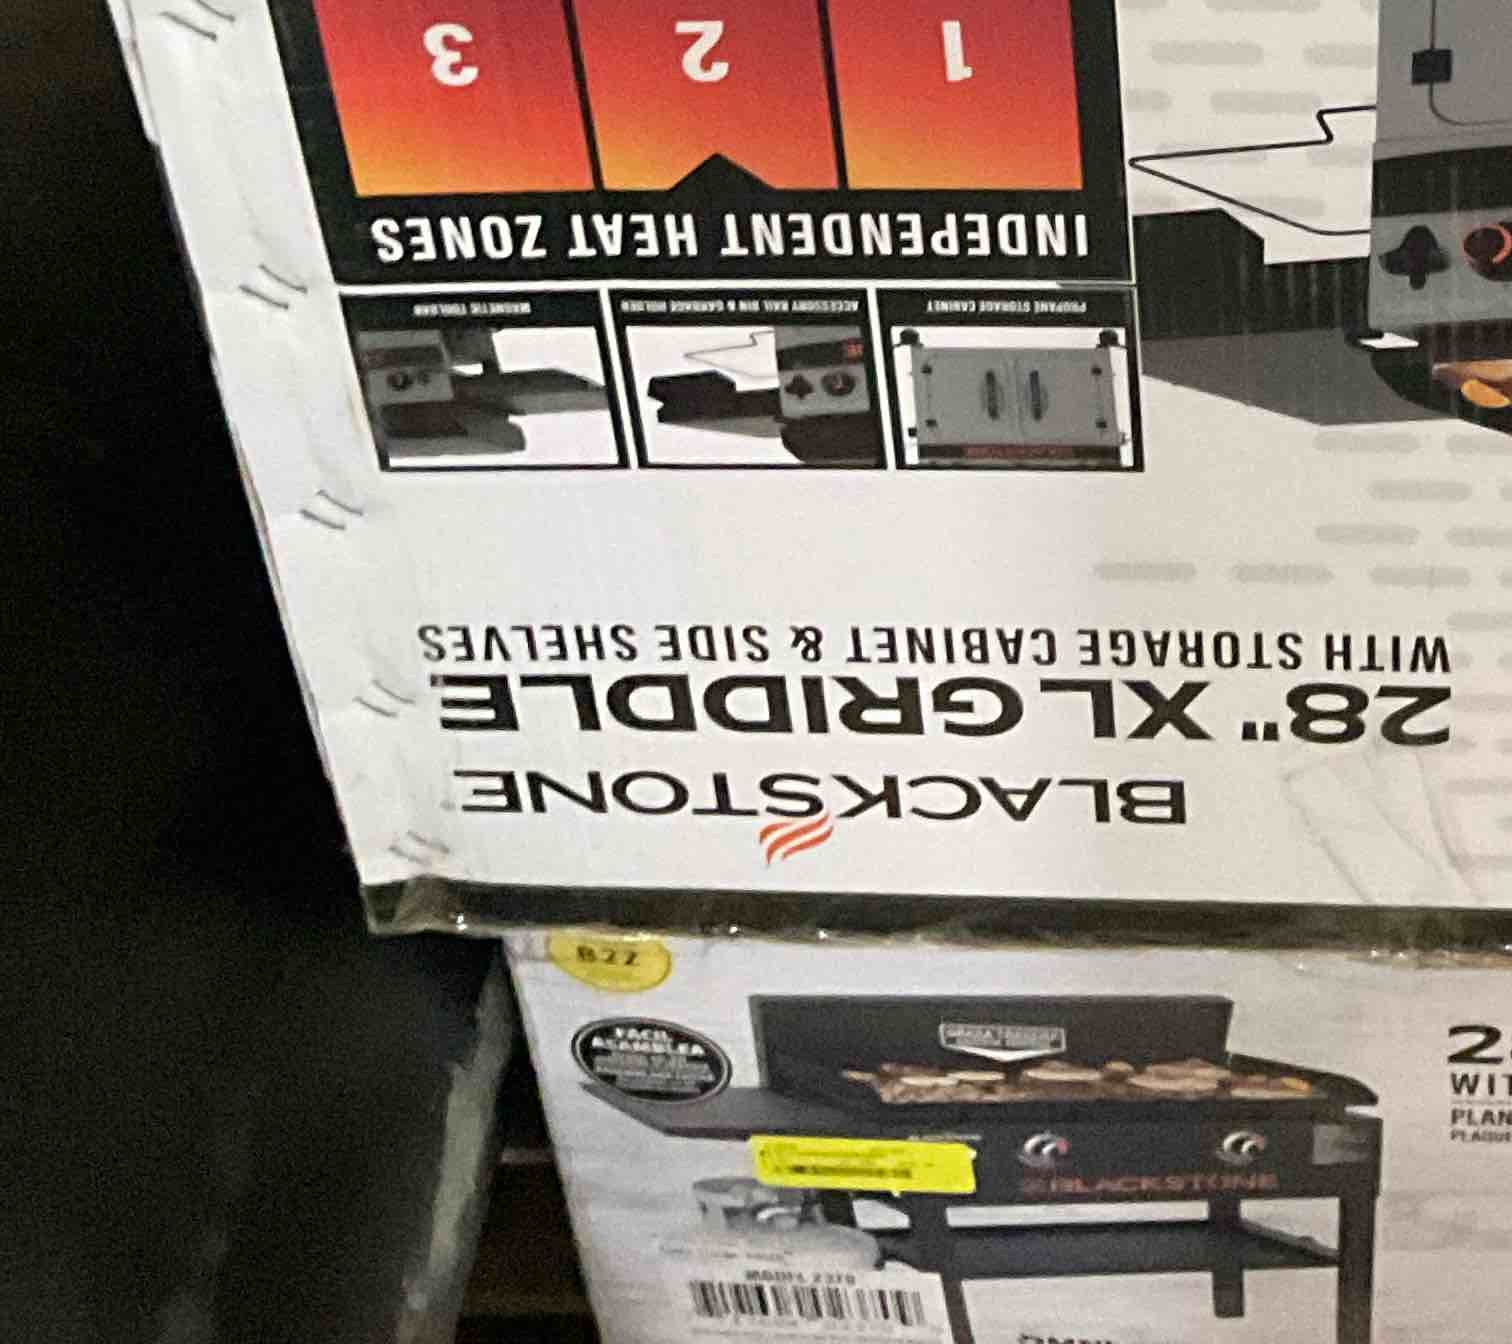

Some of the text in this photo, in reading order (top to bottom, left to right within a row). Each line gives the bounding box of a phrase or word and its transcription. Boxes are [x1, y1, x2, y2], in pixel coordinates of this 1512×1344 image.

[424, 21, 480, 86] 3
[674, 19, 729, 81] 2
[942, 19, 973, 81] 1
[369, 210, 1089, 263] INDEPENDENT HEAT ZONES
[416, 622, 1451, 673] WITH STORAGE CABINET & SIDE SHELVES
[440, 674, 1452, 744] 28" XL GRIDDLE
[453, 770, 1187, 827] BLACKSTONE
